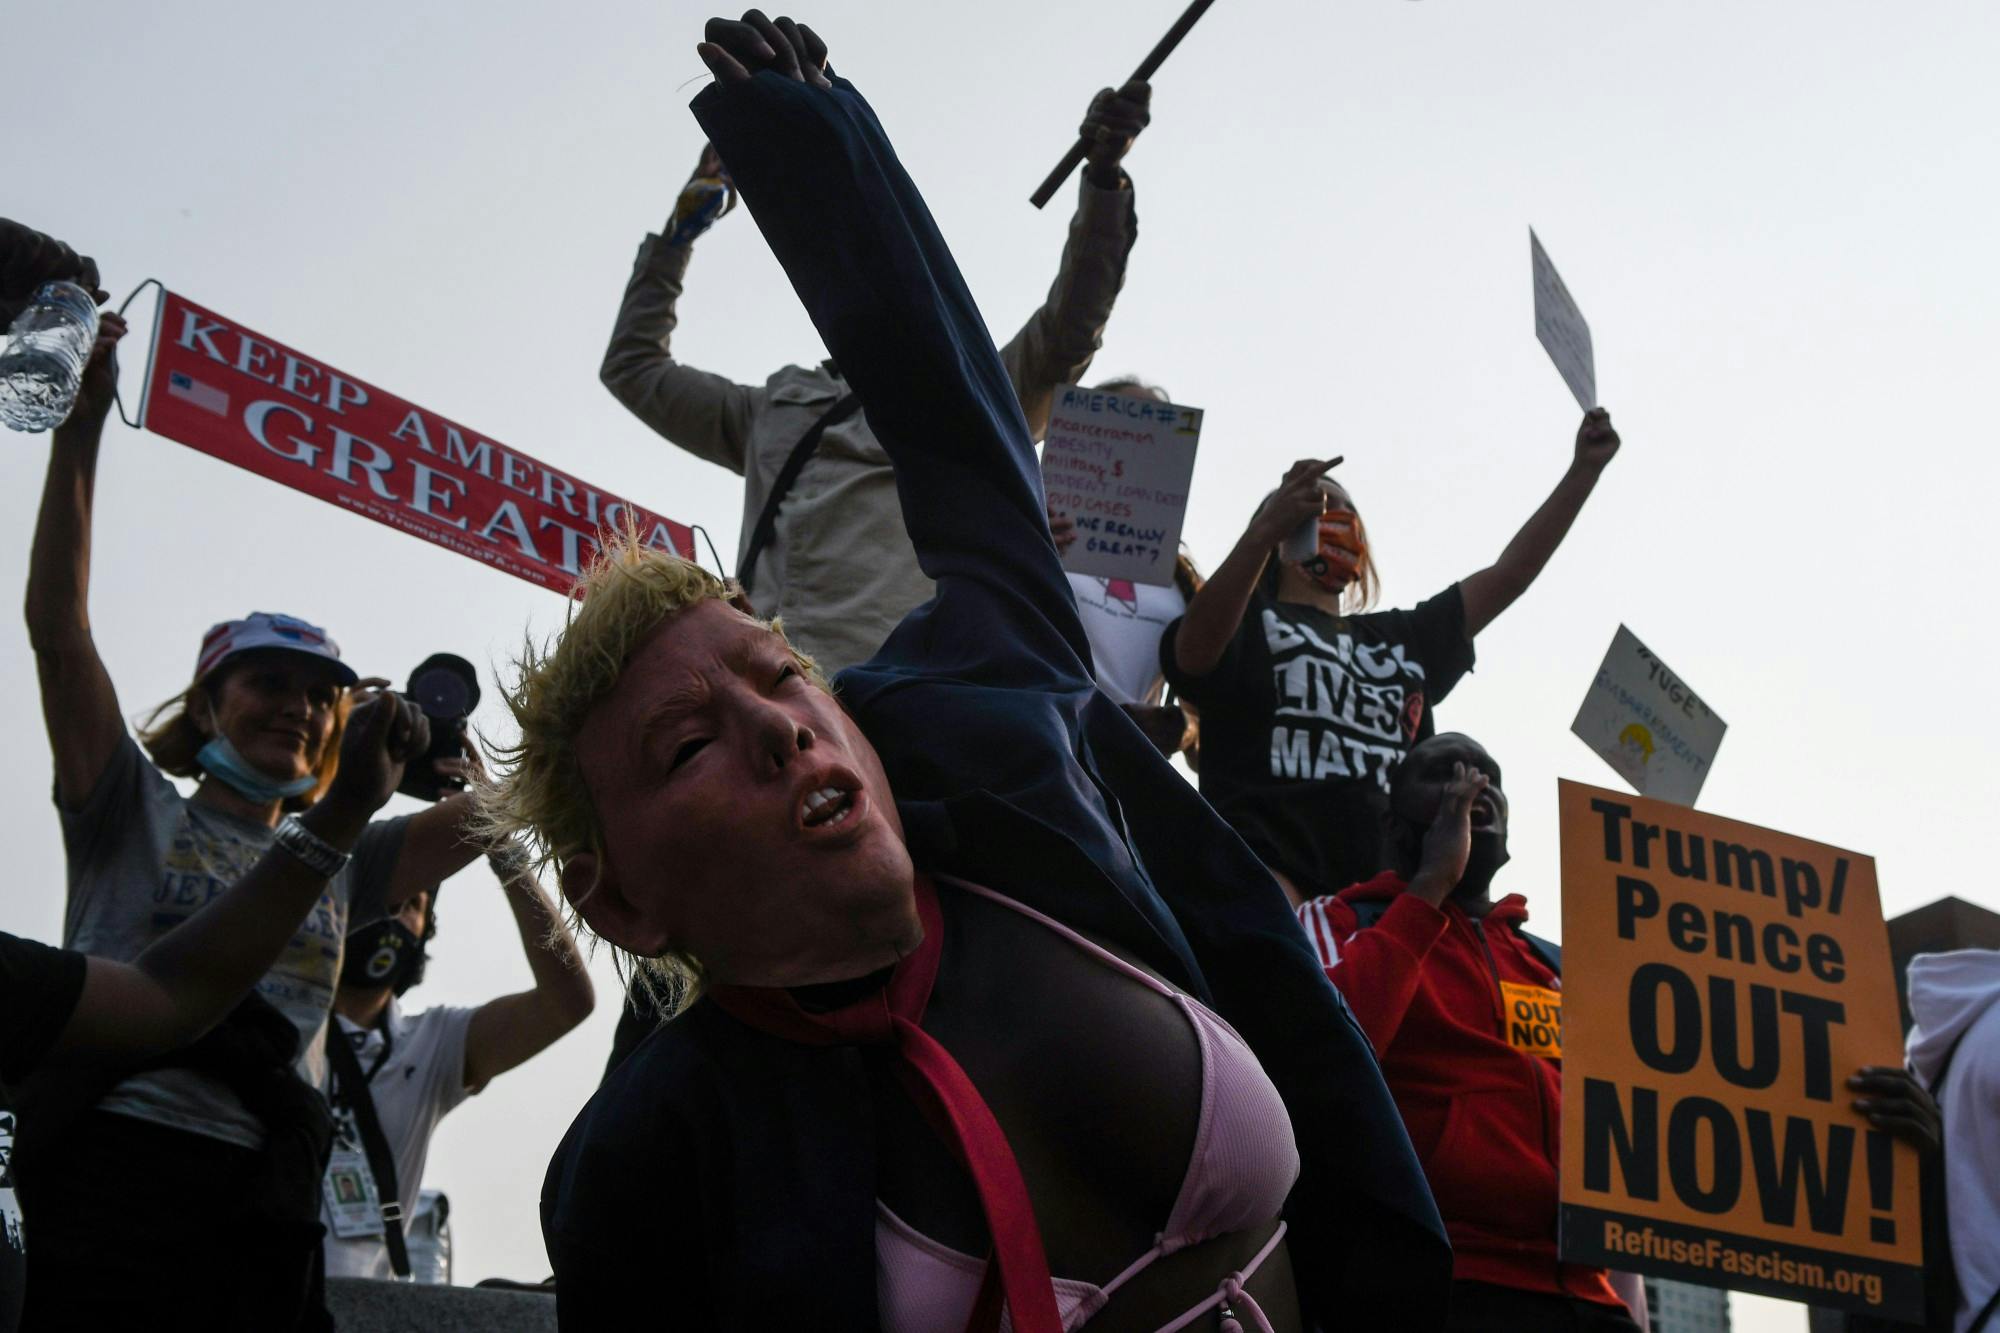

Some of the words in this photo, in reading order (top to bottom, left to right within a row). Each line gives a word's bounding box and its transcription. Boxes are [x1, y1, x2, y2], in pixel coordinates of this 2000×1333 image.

[174, 307, 369, 415] KEEP
[390, 412, 680, 556] AMERICA
[243, 400, 602, 578] GREAT
[1076, 516, 1100, 531] WE
[1591, 798, 1849, 917] Trump/
[1616, 875, 1846, 983] Pence
[1628, 963, 1845, 1102] OUT
[1583, 1077, 1896, 1245] NOW!
[1604, 1221, 1882, 1305] RefuseFascism.org
